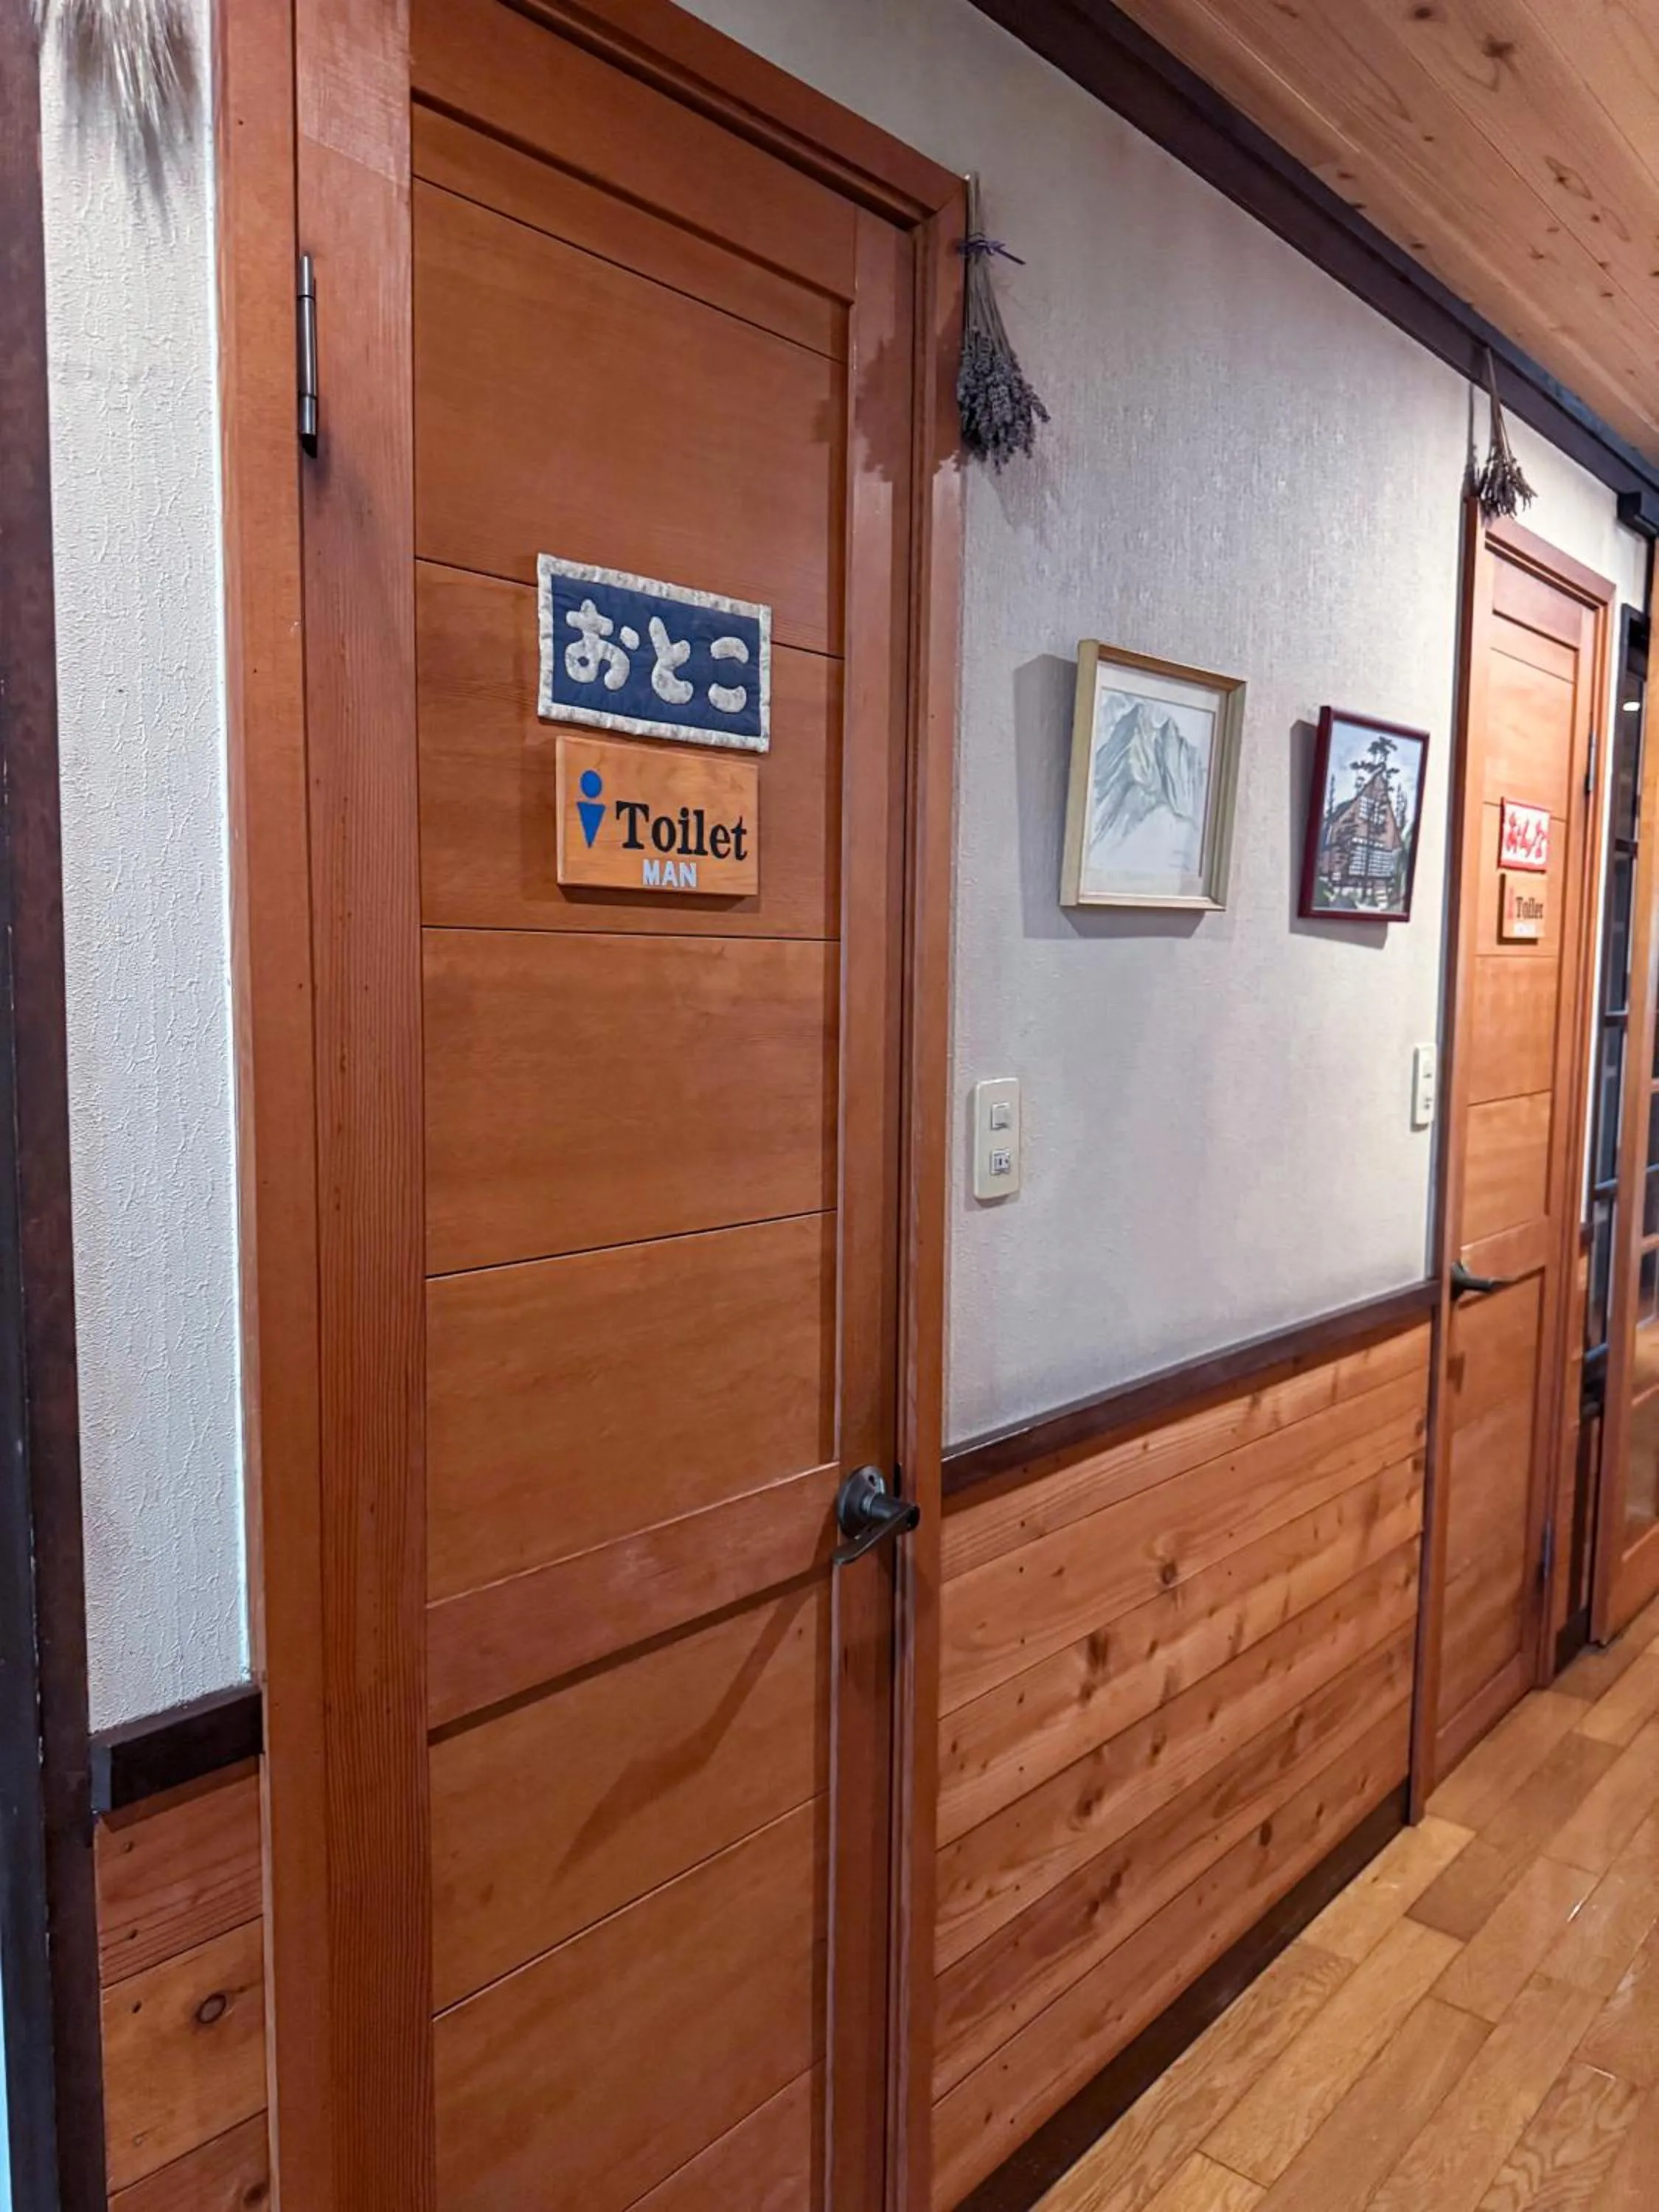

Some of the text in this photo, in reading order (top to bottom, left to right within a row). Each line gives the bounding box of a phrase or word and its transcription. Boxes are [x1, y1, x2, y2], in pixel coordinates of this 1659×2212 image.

[565, 599, 750, 714] おとこ
[615, 800, 748, 861] Toilet
[641, 858, 698, 888] MAN
